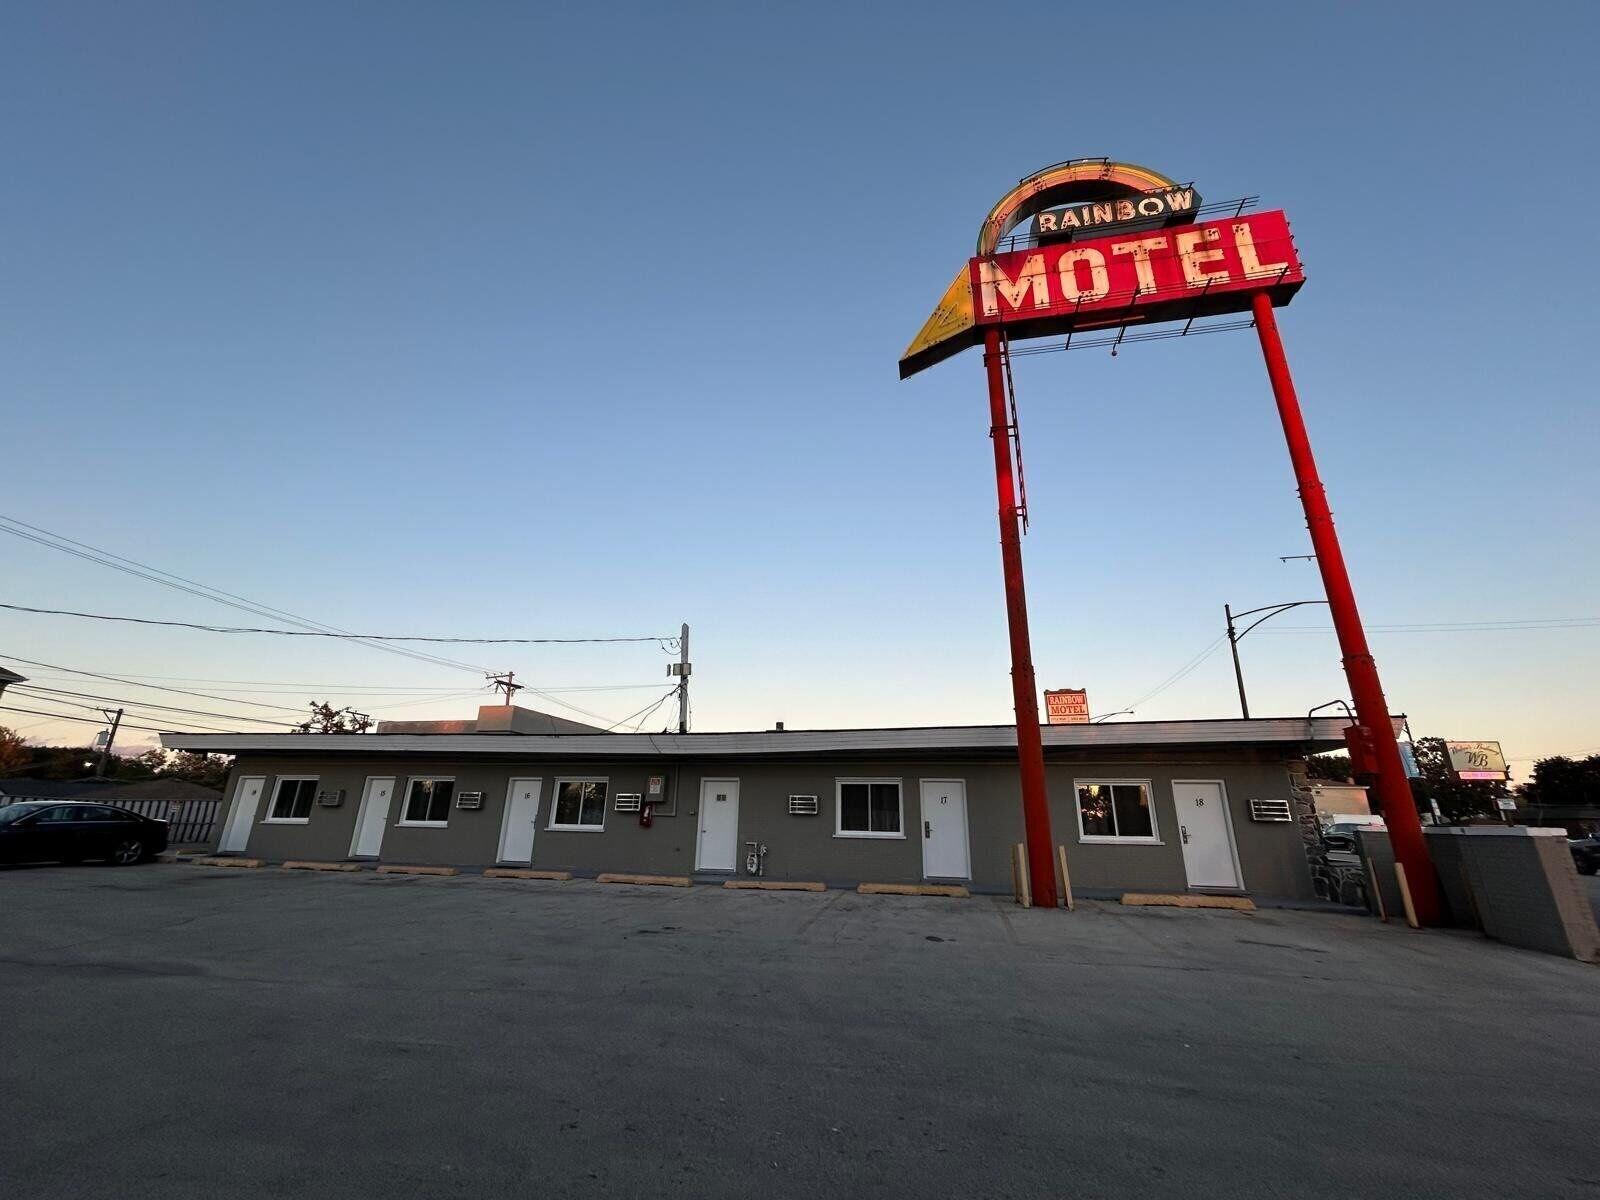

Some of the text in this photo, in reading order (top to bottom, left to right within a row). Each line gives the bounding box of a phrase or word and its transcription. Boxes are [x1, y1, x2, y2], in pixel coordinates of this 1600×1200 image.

[1038, 189, 1193, 232] RAINBOW
[979, 223, 1290, 316] MOTEL
[1049, 695, 1084, 704] RAINBOW
[1051, 705, 1085, 714] MOTEL
[1195, 798, 1204, 806] 18
